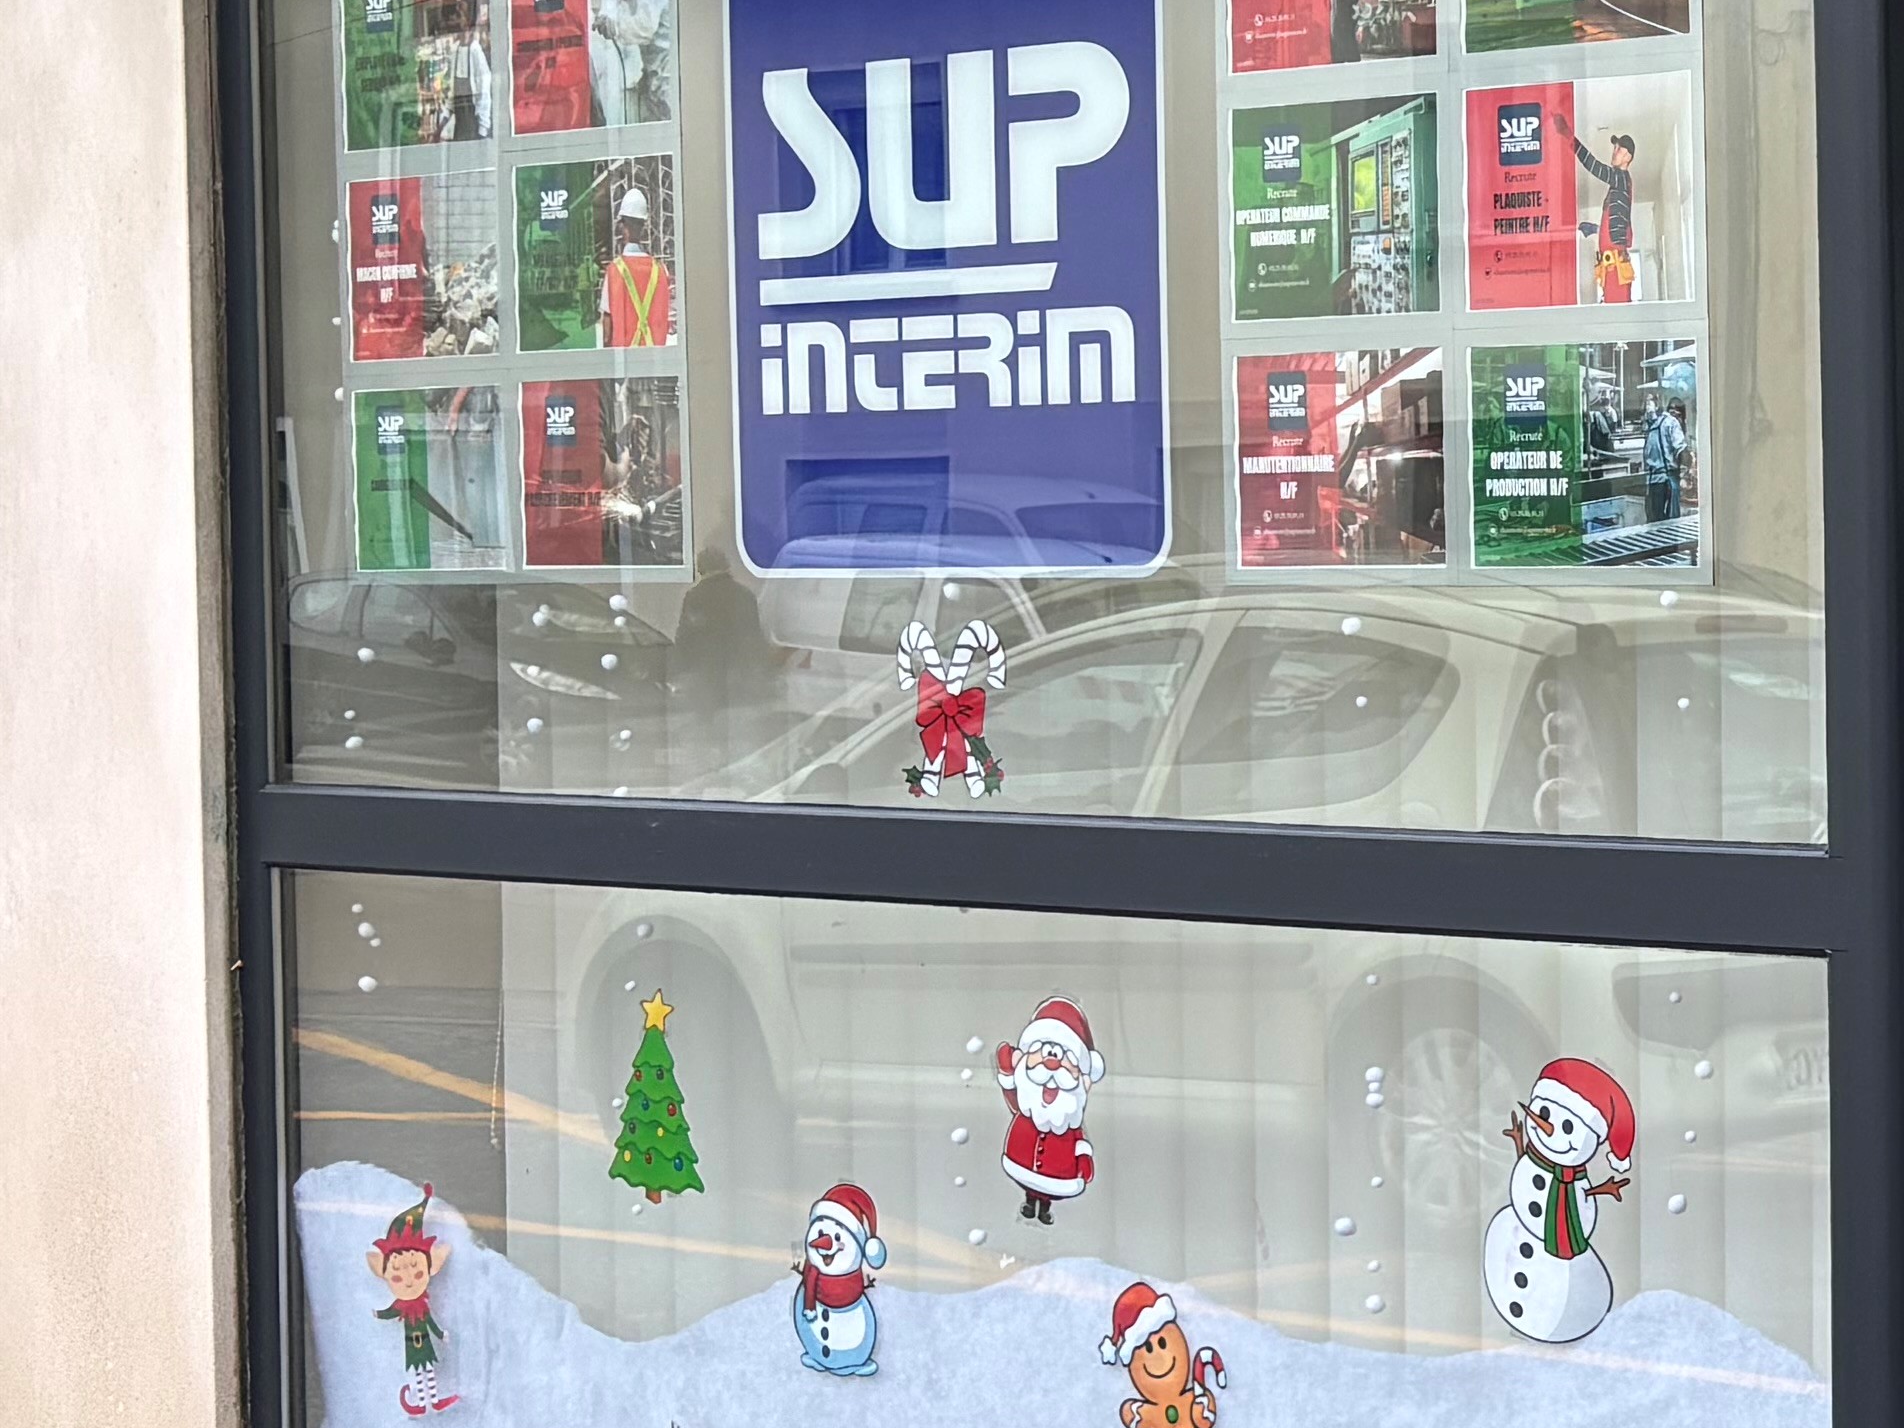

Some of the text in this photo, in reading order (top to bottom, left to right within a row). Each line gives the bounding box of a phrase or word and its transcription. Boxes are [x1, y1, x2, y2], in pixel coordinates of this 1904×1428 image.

[1500, 116, 1540, 139] SUP
[757, 40, 1131, 260] SUP
[1263, 135, 1300, 156] SUP
[1493, 190, 1542, 210] PLAQUISTE
[1268, 384, 1305, 404] SUP
[1505, 376, 1545, 397] SUP
[1485, 478, 1548, 498] PRODUCTION
